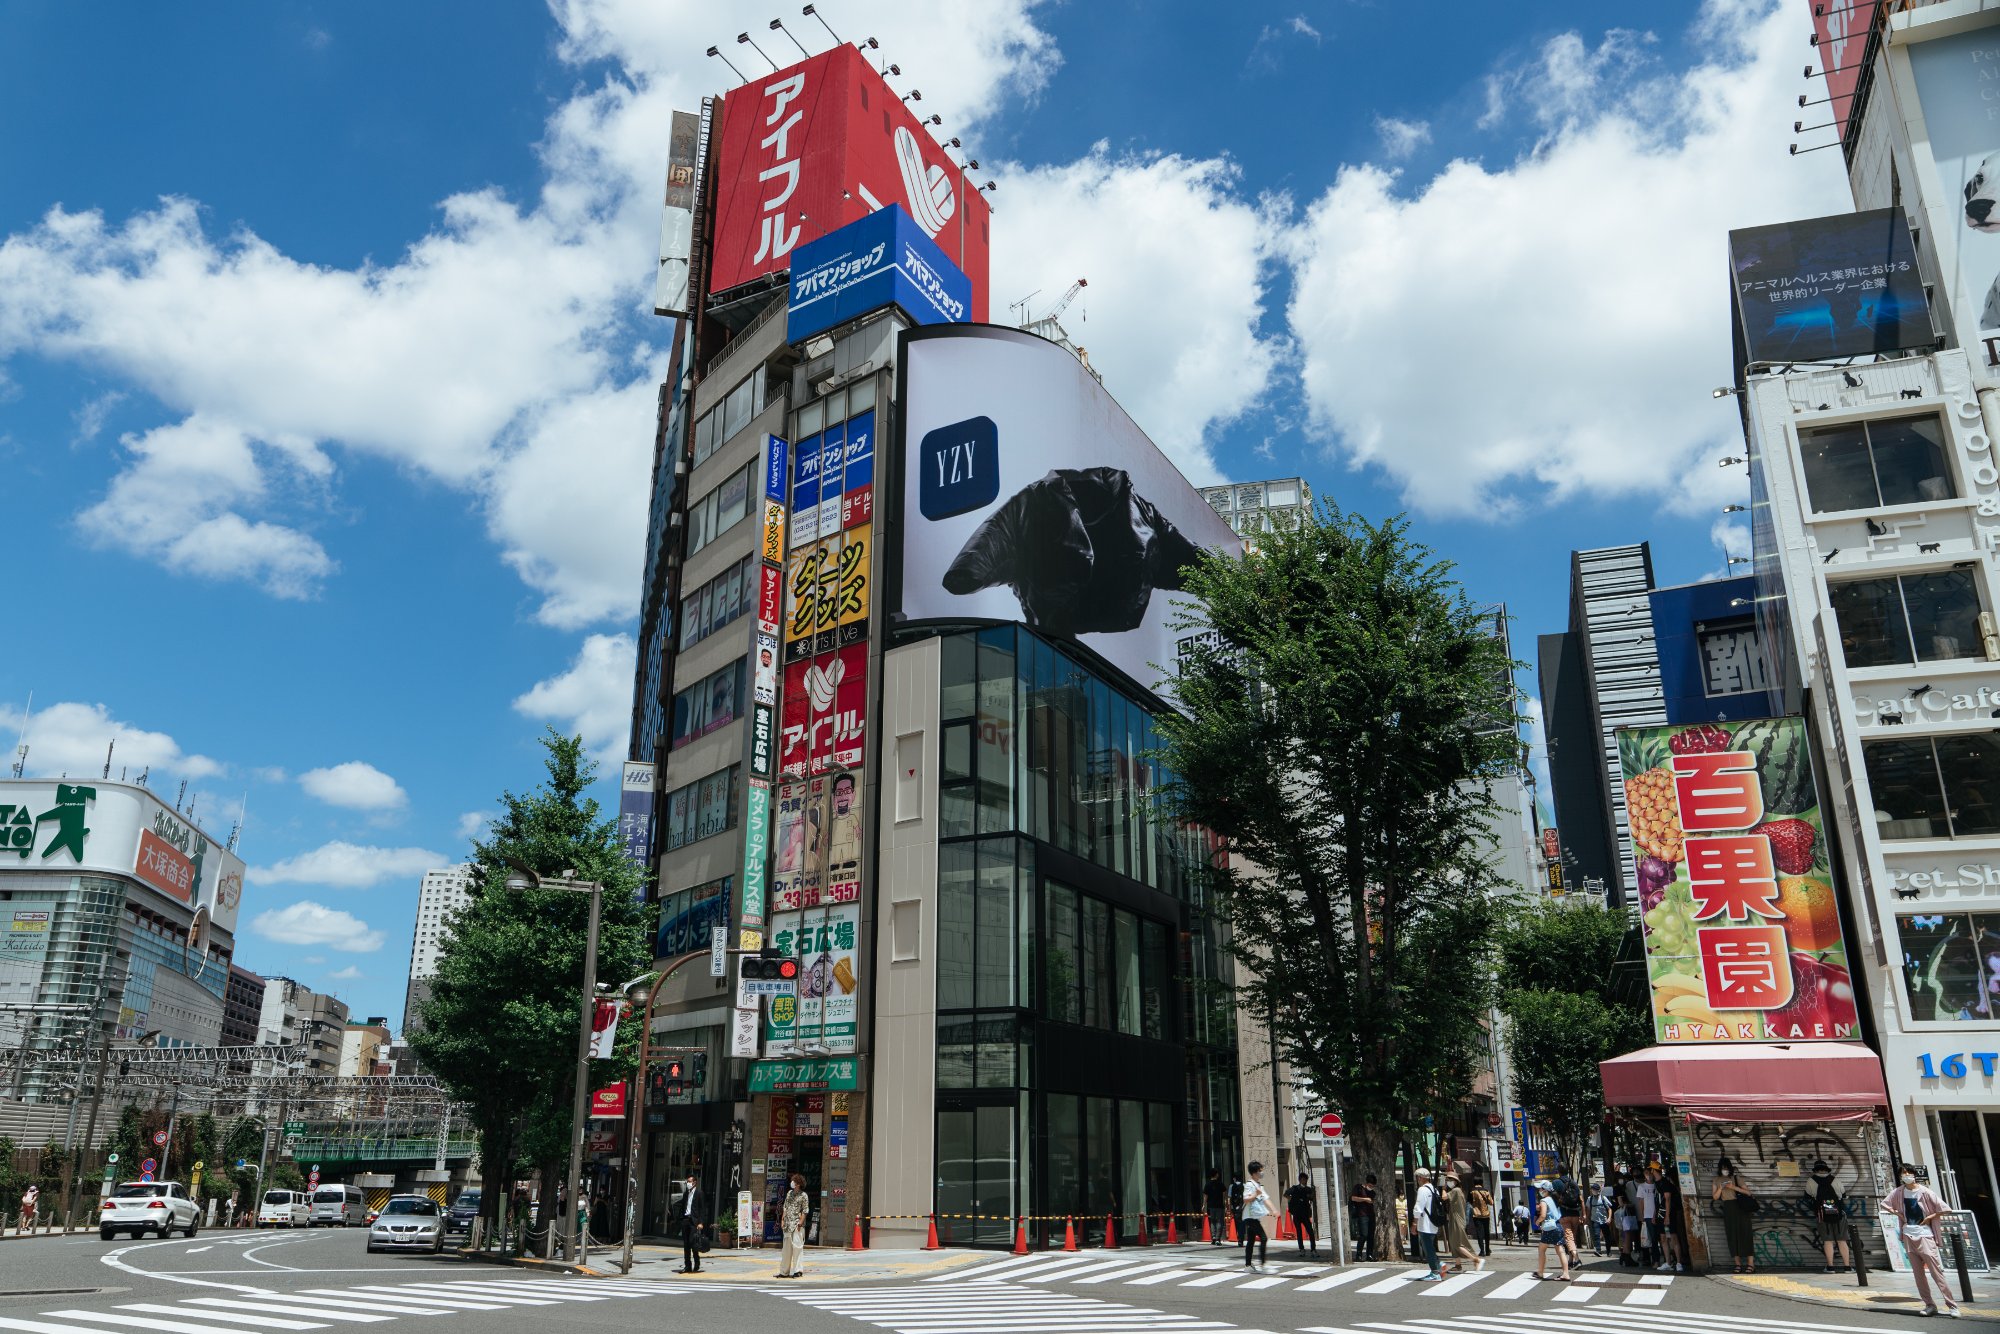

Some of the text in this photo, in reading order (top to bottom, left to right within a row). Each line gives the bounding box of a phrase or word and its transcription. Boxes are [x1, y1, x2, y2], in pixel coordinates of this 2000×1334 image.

[753, 72, 806, 266] アイフル
[796, 250, 853, 280] Dramatic Communication
[796, 242, 885, 300] アパマンショップ
[1740, 260, 1911, 294] アニマルヘルス業界における
[905, 249, 964, 319] アパマンショップ
[1769, 277, 1888, 305] 世界的リーダー企業
[936, 440, 976, 489] YZY
[844, 492, 872, 510] 当ビル
[767, 504, 781, 560] ダーツグッズ
[794, 541, 864, 598] ダーツ
[765, 580, 776, 621] アイフル
[793, 575, 865, 636] グッズ
[761, 620, 774, 631] 4F
[1854, 692, 1917, 717] Cat
[754, 708, 769, 773] 宝石広場
[783, 710, 865, 757] アイフル
[627, 771, 652, 785] HIS
[142, 845, 191, 891] 大塚商会
[745, 789, 766, 915] カメラのアルプス堂
[774, 881, 791, 893] Dr.
[1672, 750, 1795, 1010] 百果園
[775, 921, 855, 957] 宝石広場
[748, 983, 791, 992] 自転車専用
[775, 997, 795, 1013] 買取
[773, 1012, 795, 1023] SHOP
[828, 1009, 852, 1018] ジュエリー
[1664, 1022, 1853, 1040] HYAKKAEN
[753, 1061, 853, 1083] カメラのアルプス堂
